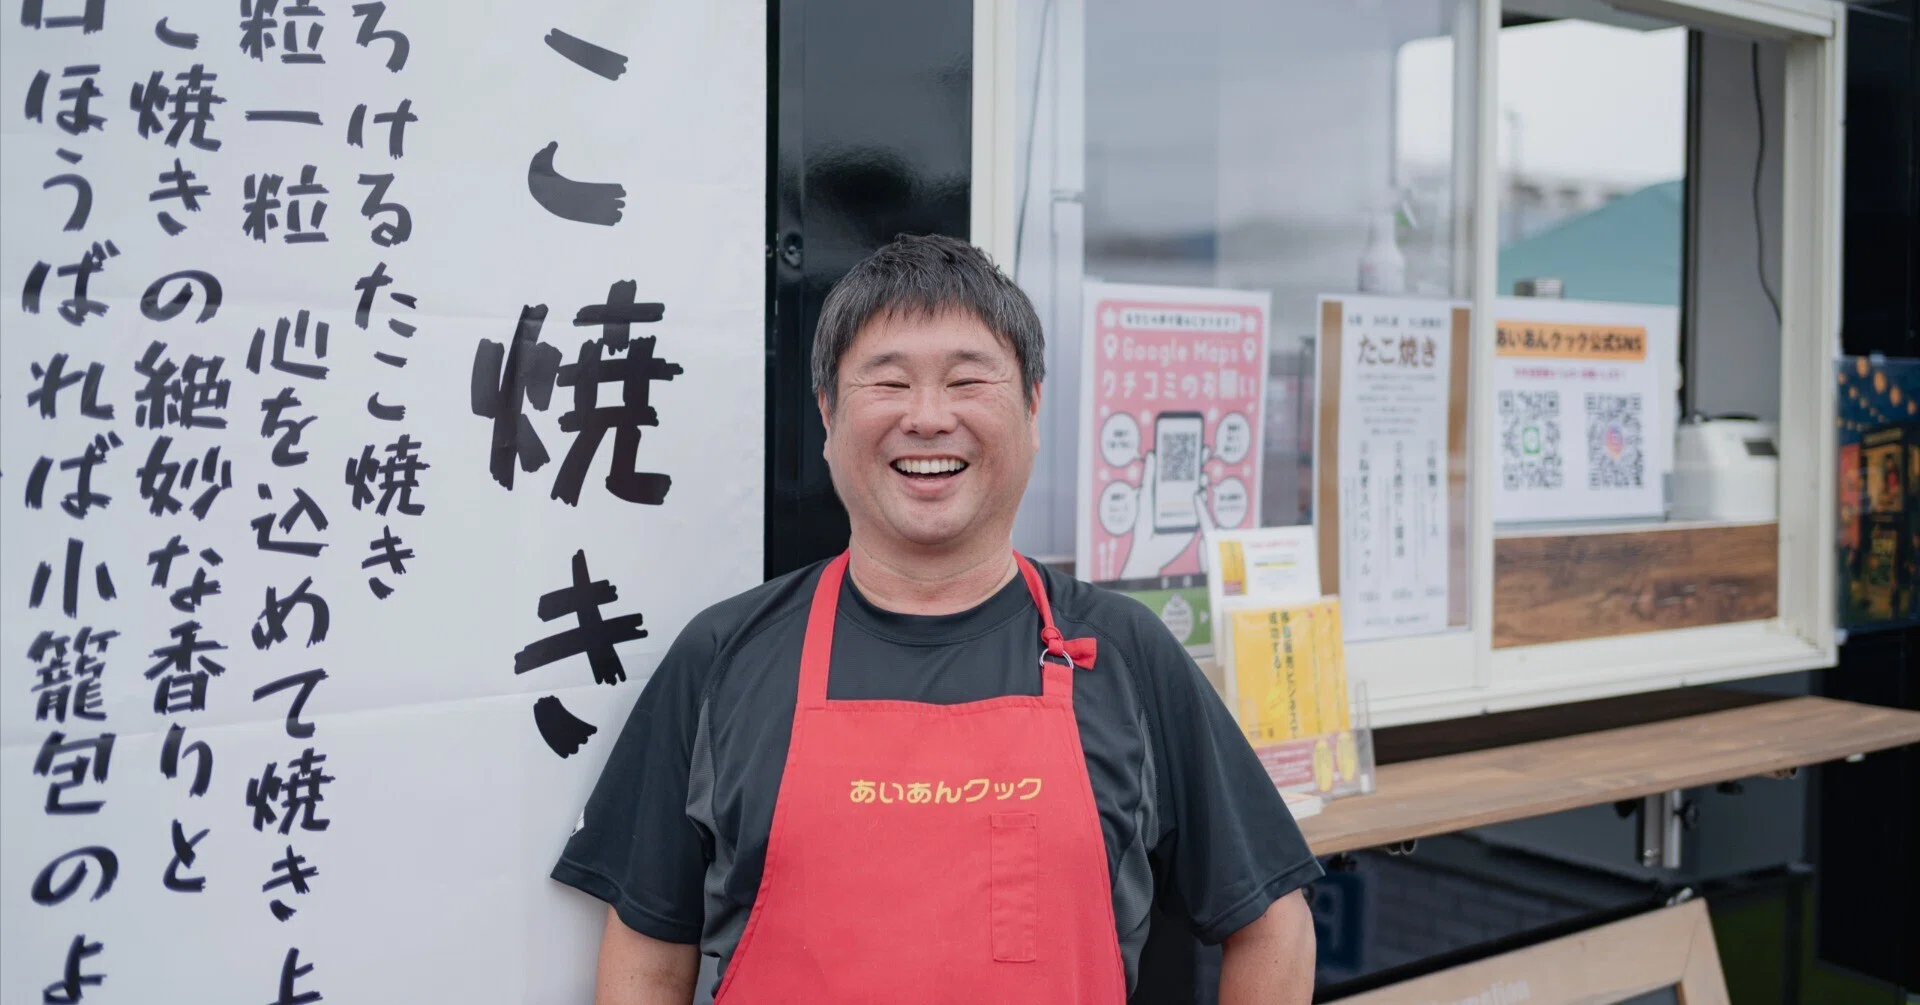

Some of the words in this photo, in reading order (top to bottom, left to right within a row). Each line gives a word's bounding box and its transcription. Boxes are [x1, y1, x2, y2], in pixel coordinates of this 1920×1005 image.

[345, 1, 430, 600] ろけるたこ焼き
[1122, 336, 1188, 367] Google
[1193, 340, 1239, 367] Maps
[1357, 334, 1437, 368] たこ焼き
[471, 27, 684, 759] こ焼き
[1102, 368, 1255, 400] クチコミのお願い
[850, 778, 1042, 804] あいあんクック
